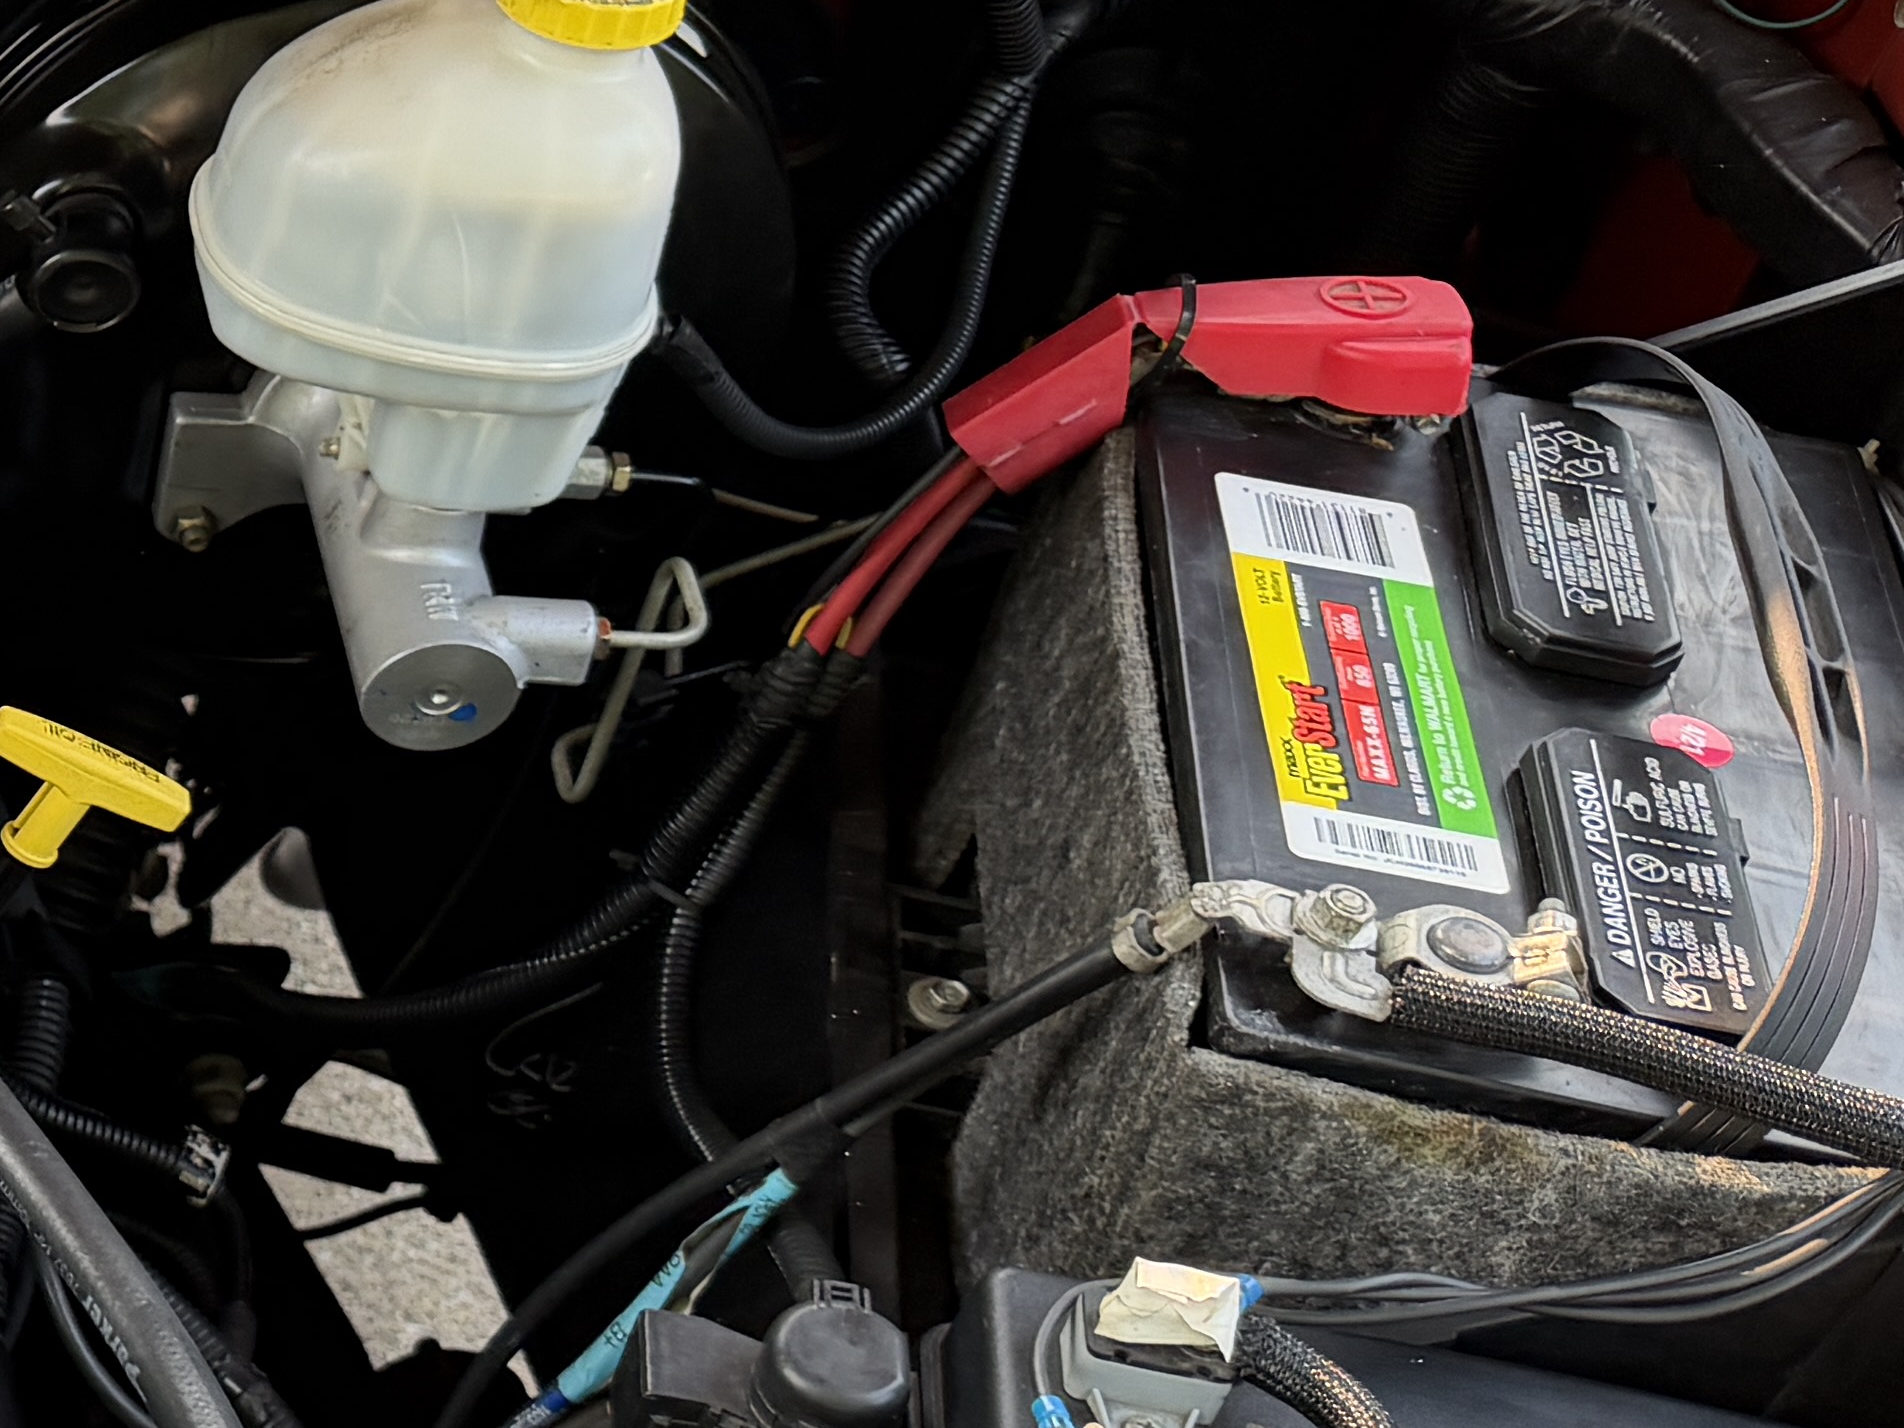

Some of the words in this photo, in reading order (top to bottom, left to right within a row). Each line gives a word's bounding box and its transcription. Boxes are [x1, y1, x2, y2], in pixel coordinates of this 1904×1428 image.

[1252, 567, 1270, 604] 12-VOLT
[1266, 569, 1286, 603] Battery
[1339, 612, 1363, 642] 1000
[1414, 672, 1443, 732] WALMART
[1280, 678, 1350, 802] EverStart
[1280, 736, 1300, 777] maxx
[1357, 703, 1391, 781] MAXX-65N
[1429, 732, 1446, 745] to
[1432, 745, 1456, 785] Return
[1567, 767, 1612, 846] POISON
[1587, 859, 1635, 947] DANGER
[1642, 905, 1668, 947] SHIELD
[1662, 918, 1686, 950] EYES
[1675, 917, 1708, 978] EXPLOSIVE
